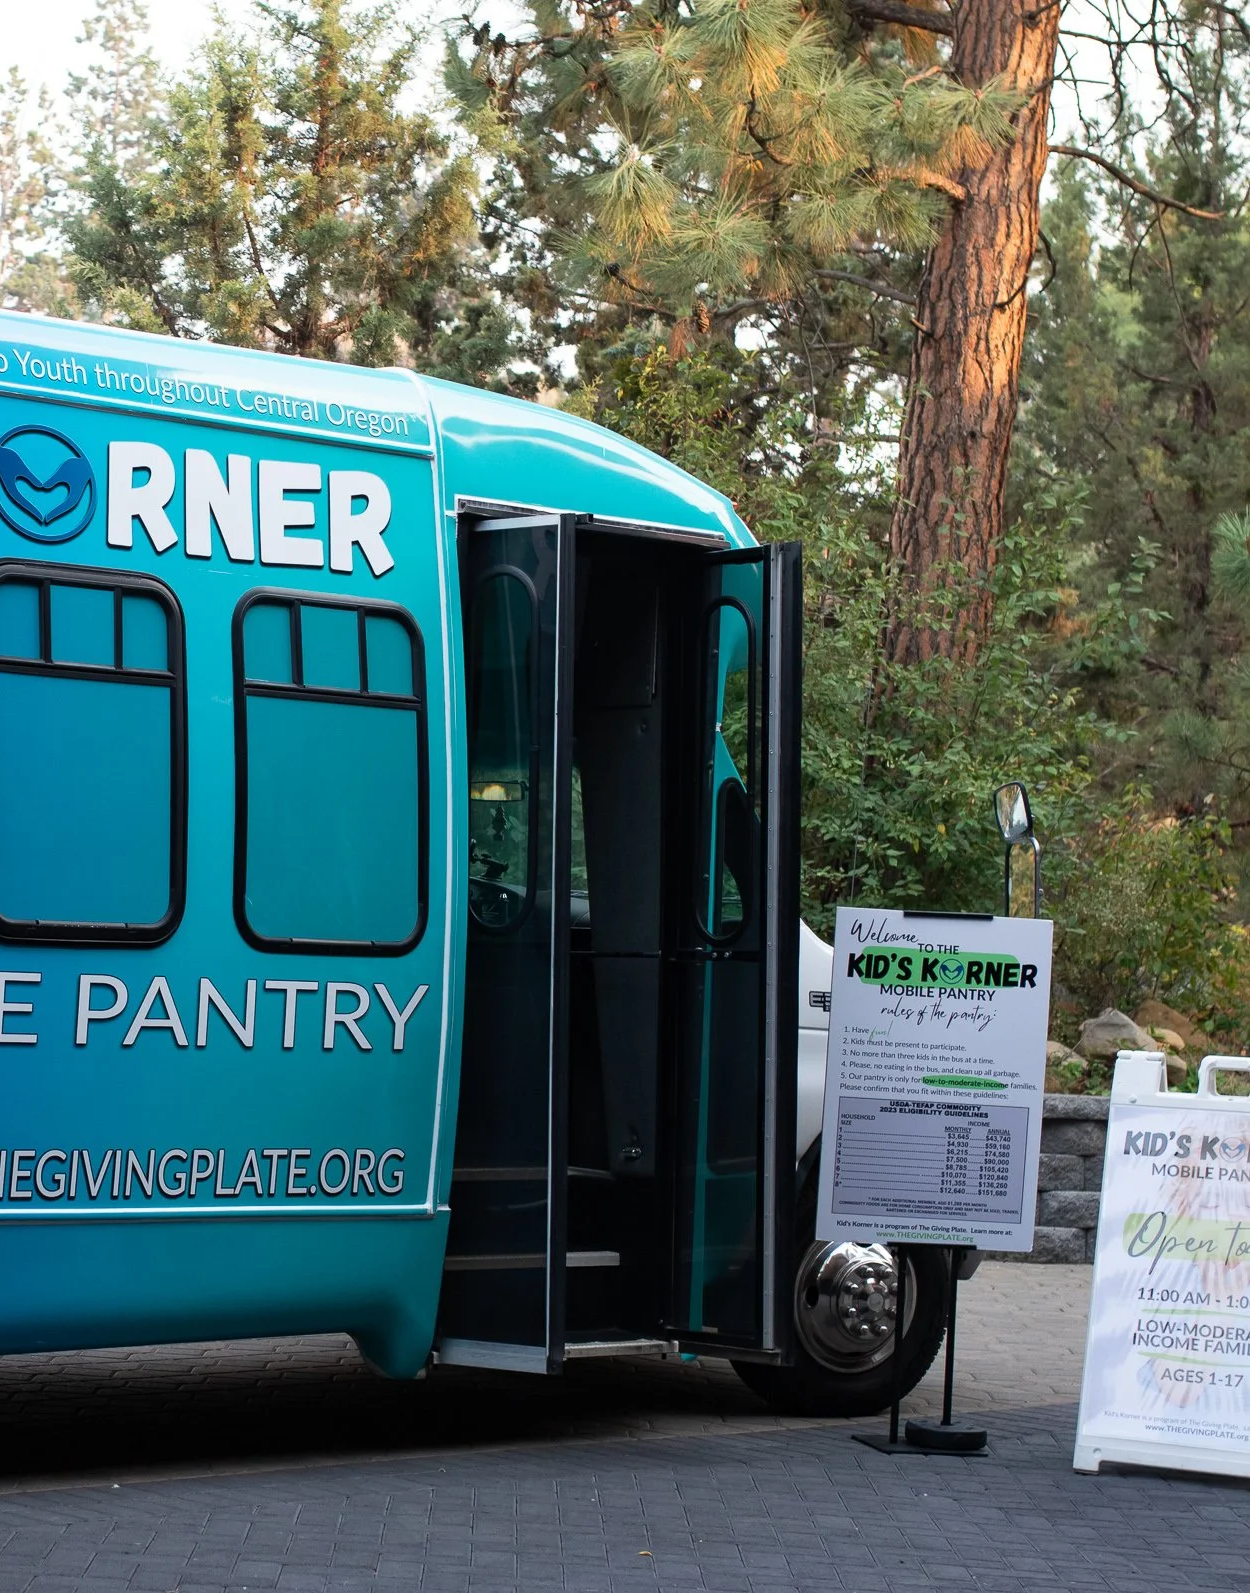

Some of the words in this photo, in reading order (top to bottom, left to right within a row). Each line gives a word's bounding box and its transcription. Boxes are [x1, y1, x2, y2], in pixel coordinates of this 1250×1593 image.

[12, 348, 88, 386] Youth
[94, 362, 230, 409] throughout
[236, 388, 319, 423] Central
[325, 401, 409, 439] Oregon
[850, 917, 919, 944] Welcome
[918, 943, 934, 954] TO
[937, 945, 960, 955] THE
[880, 983, 935, 998] MOBILE
[938, 987, 996, 1001] PANTRY
[74, 974, 429, 1053] PANTRY
[880, 996, 914, 1020] rules
[917, 1005, 928, 1026] of
[930, 998, 947, 1021] the
[946, 1005, 997, 1032] pantry:
[851, 1026, 870, 1034] Have
[842, 1037, 849, 1045] 2.
[850, 1038, 865, 1046] Kids
[894, 1042, 920, 1051] present
[929, 1043, 966, 1052] participate.
[850, 1049, 860, 1057] No
[880, 1051, 896, 1059] than
[897, 1052, 915, 1060] three
[916, 1053, 929, 1061] kids
[931, 1053, 938, 1061] in
[951, 1055, 963, 1063] bus
[978, 1057, 995, 1065] time.
[849, 1061, 872, 1069] Please,
[884, 1063, 905, 1072] eating
[926, 1066, 940, 1074] bus,
[973, 1069, 982, 1077] up
[993, 1070, 1021, 1078] garbage.
[863, 1074, 886, 1083] pantry
[894, 1076, 909, 1084] only
[922, 1077, 1009, 1089] low-to-moderate-income
[1010, 1083, 1037, 1091] families.
[839, 1083, 862, 1091] Please
[863, 1084, 890, 1092] confirm
[906, 1088, 919, 1096] you
[973, 1091, 1009, 1100] guidelines:
[889, 1100, 934, 1109] USDA-TEFAP
[936, 1103, 981, 1111] COMMODITY
[898, 1107, 942, 1115] ELIGIBILITY
[944, 1110, 989, 1118] GUIDELINES
[1151, 1162, 1214, 1180] MOBILE
[876, 1231, 974, 1243] www.THEGIVINGPLATE.org
[931, 1225, 950, 1233] Giving
[1128, 1211, 1217, 1275] Open
[1137, 1287, 1180, 1303] 11:00
[1182, 1291, 1211, 1305] AM
[1226, 1295, 1250, 1309] 1:0
[1132, 1332, 1200, 1351] INCOME
[1161, 1367, 1204, 1384] AGES
[1208, 1372, 1244, 1388] 1-17
[1145, 1424, 1249, 1441] www.THEGIVINGPLATE.org
